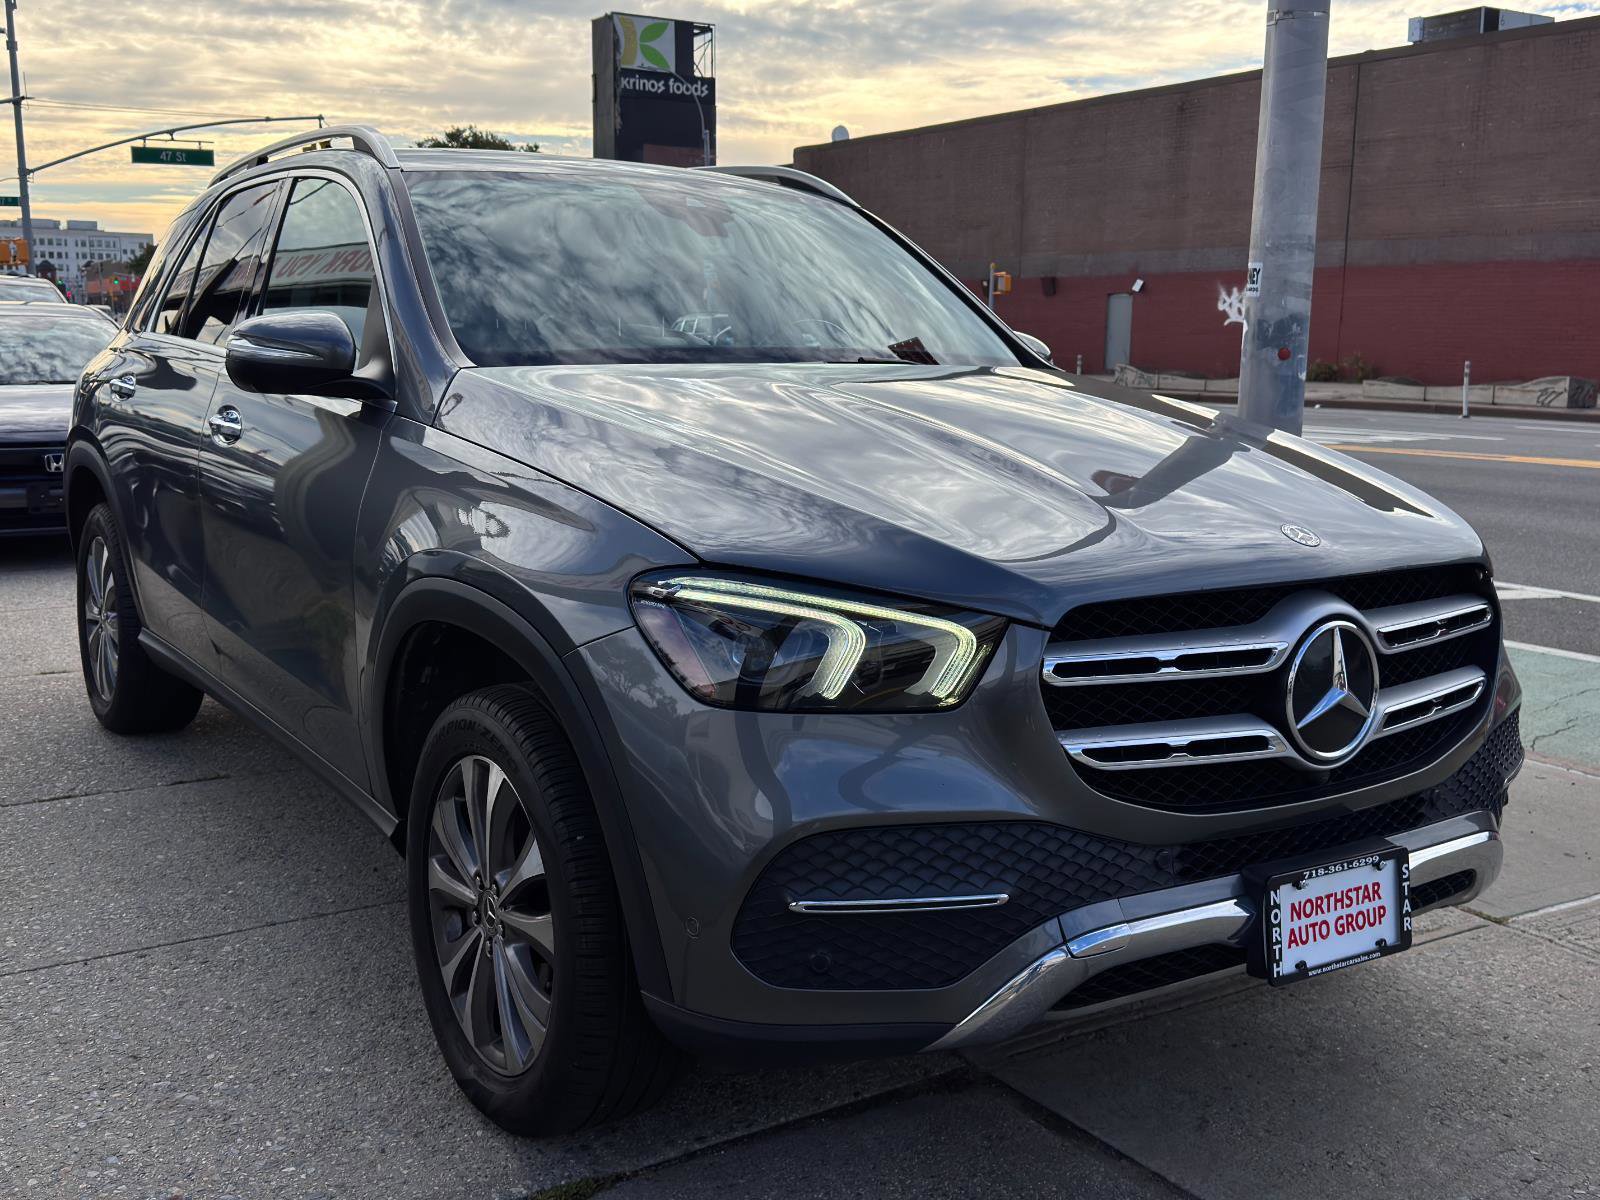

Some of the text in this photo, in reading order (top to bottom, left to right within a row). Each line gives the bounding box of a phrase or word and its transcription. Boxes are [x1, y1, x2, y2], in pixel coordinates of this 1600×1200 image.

[621, 74, 708, 97] krinos foods
[160, 150, 187, 162] 47 St
[1303, 855, 1380, 880] 718-361-6299
[1290, 881, 1382, 922] NORTHSTAR
[1401, 864, 1412, 932] STAR
[1270, 889, 1283, 978] NORTH
[1287, 905, 1387, 949] AUTO GROUP
